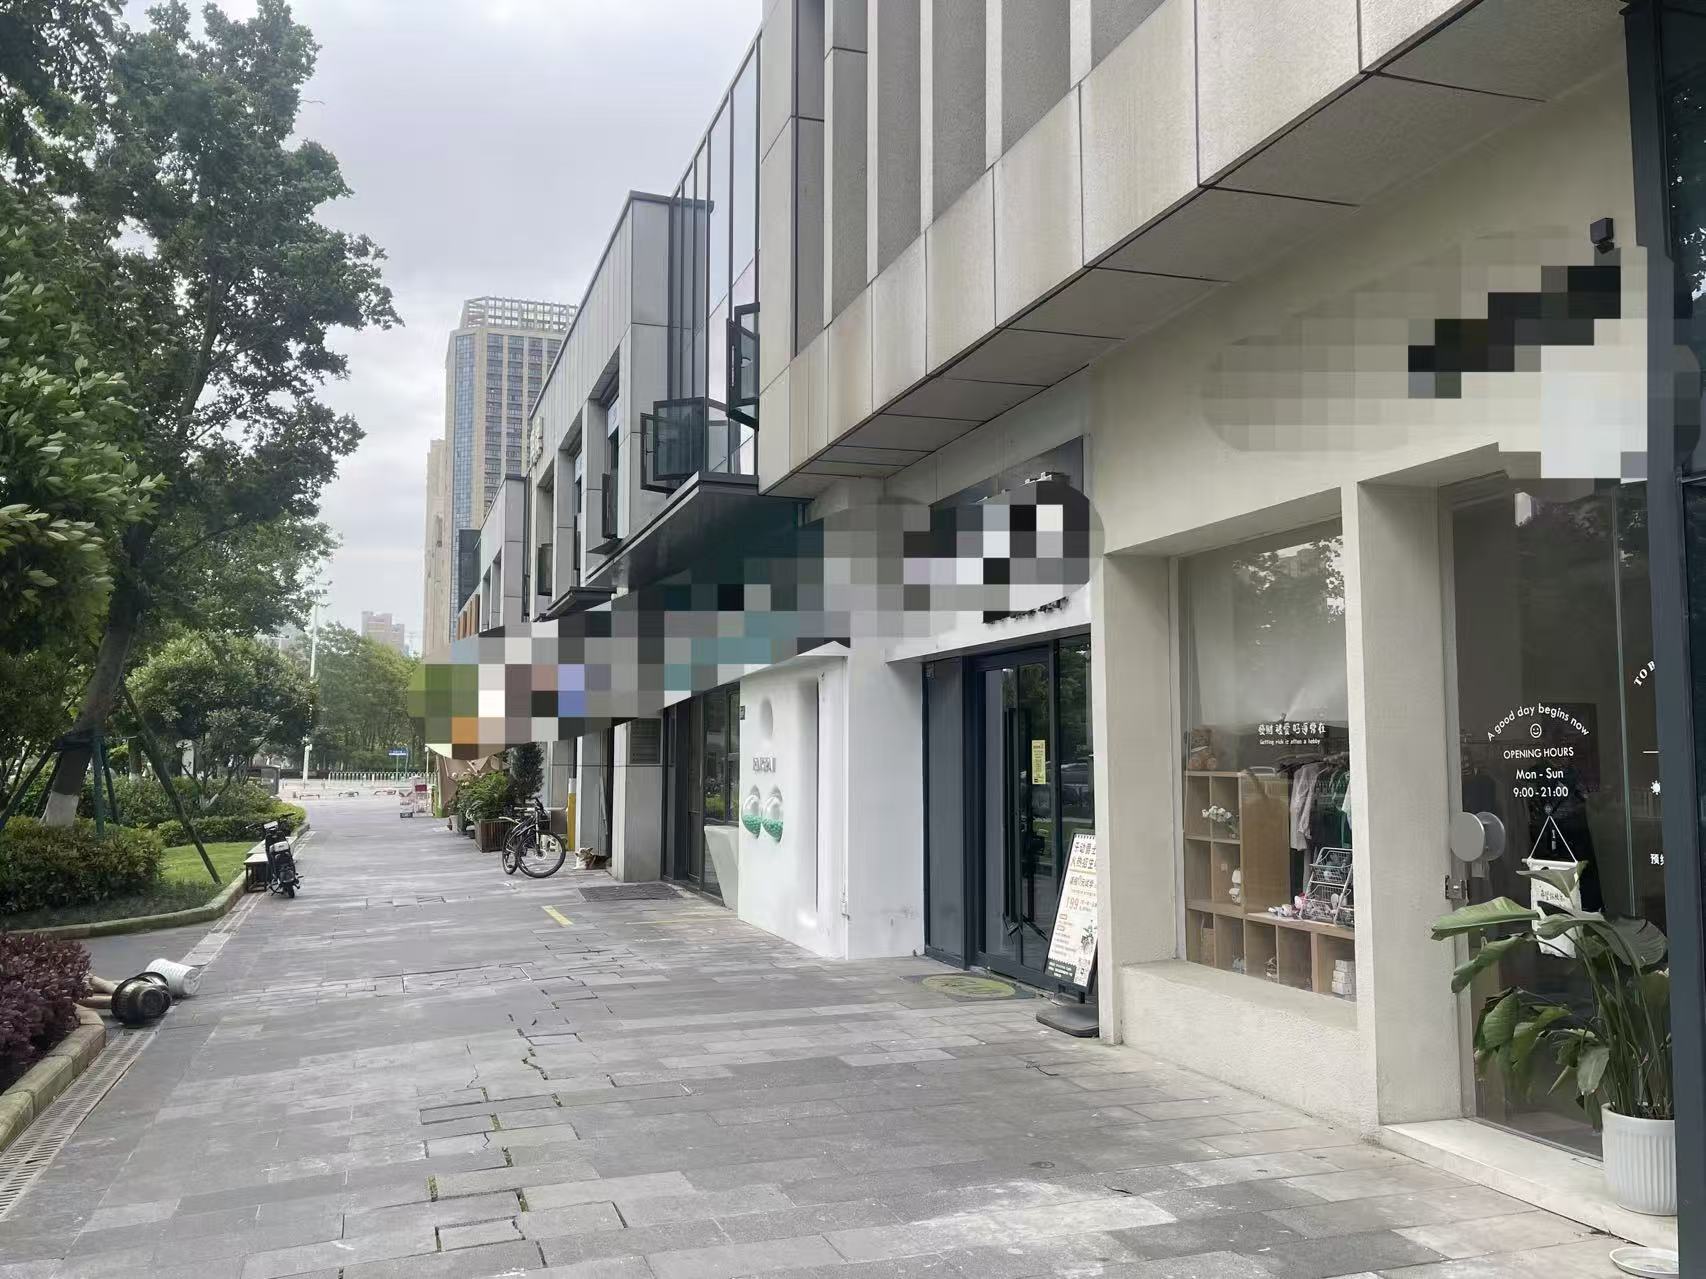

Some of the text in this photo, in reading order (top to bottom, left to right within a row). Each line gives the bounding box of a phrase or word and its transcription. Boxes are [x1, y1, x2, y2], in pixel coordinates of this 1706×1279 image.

[1633, 668, 1648, 687] TO
[1487, 703, 1590, 742] A good day begins now
[1503, 746, 1574, 759] OPENING HOURS
[1515, 768, 1537, 780] Mon
[1545, 767, 1564, 779] Sun
